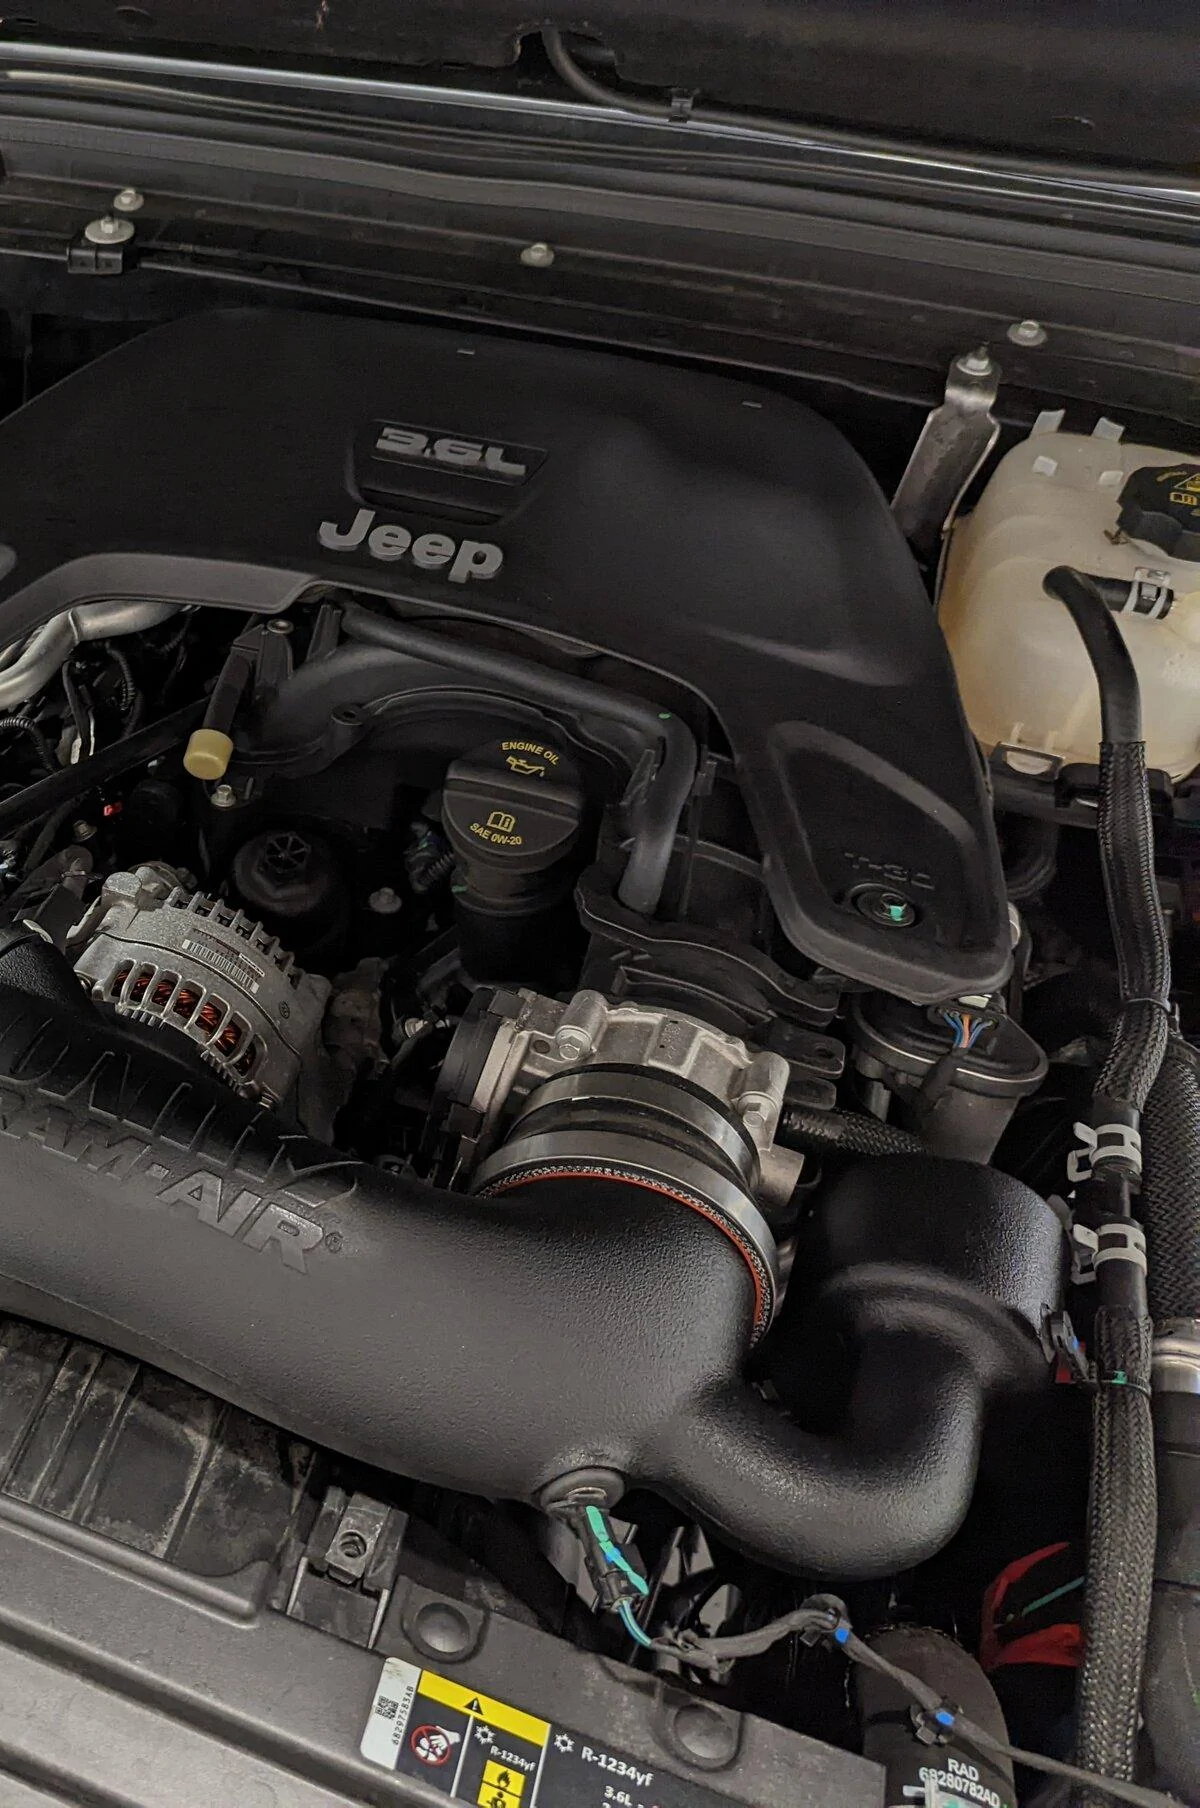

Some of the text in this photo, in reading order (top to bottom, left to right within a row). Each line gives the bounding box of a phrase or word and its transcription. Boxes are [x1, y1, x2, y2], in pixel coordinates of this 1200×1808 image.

[373, 426, 527, 476] 3.6L
[318, 508, 504, 584] Jeep
[501, 741, 561, 765] ENGINE OIL
[470, 822, 522, 845] SAE 0W-20
[489, 1745, 537, 1772] R-1234yf
[580, 1745, 654, 1787] R-1234yf
[947, 1757, 979, 1781] RAD
[603, 1785, 633, 1807] 3.6L
[918, 1766, 1000, 1808] 68280782AD
